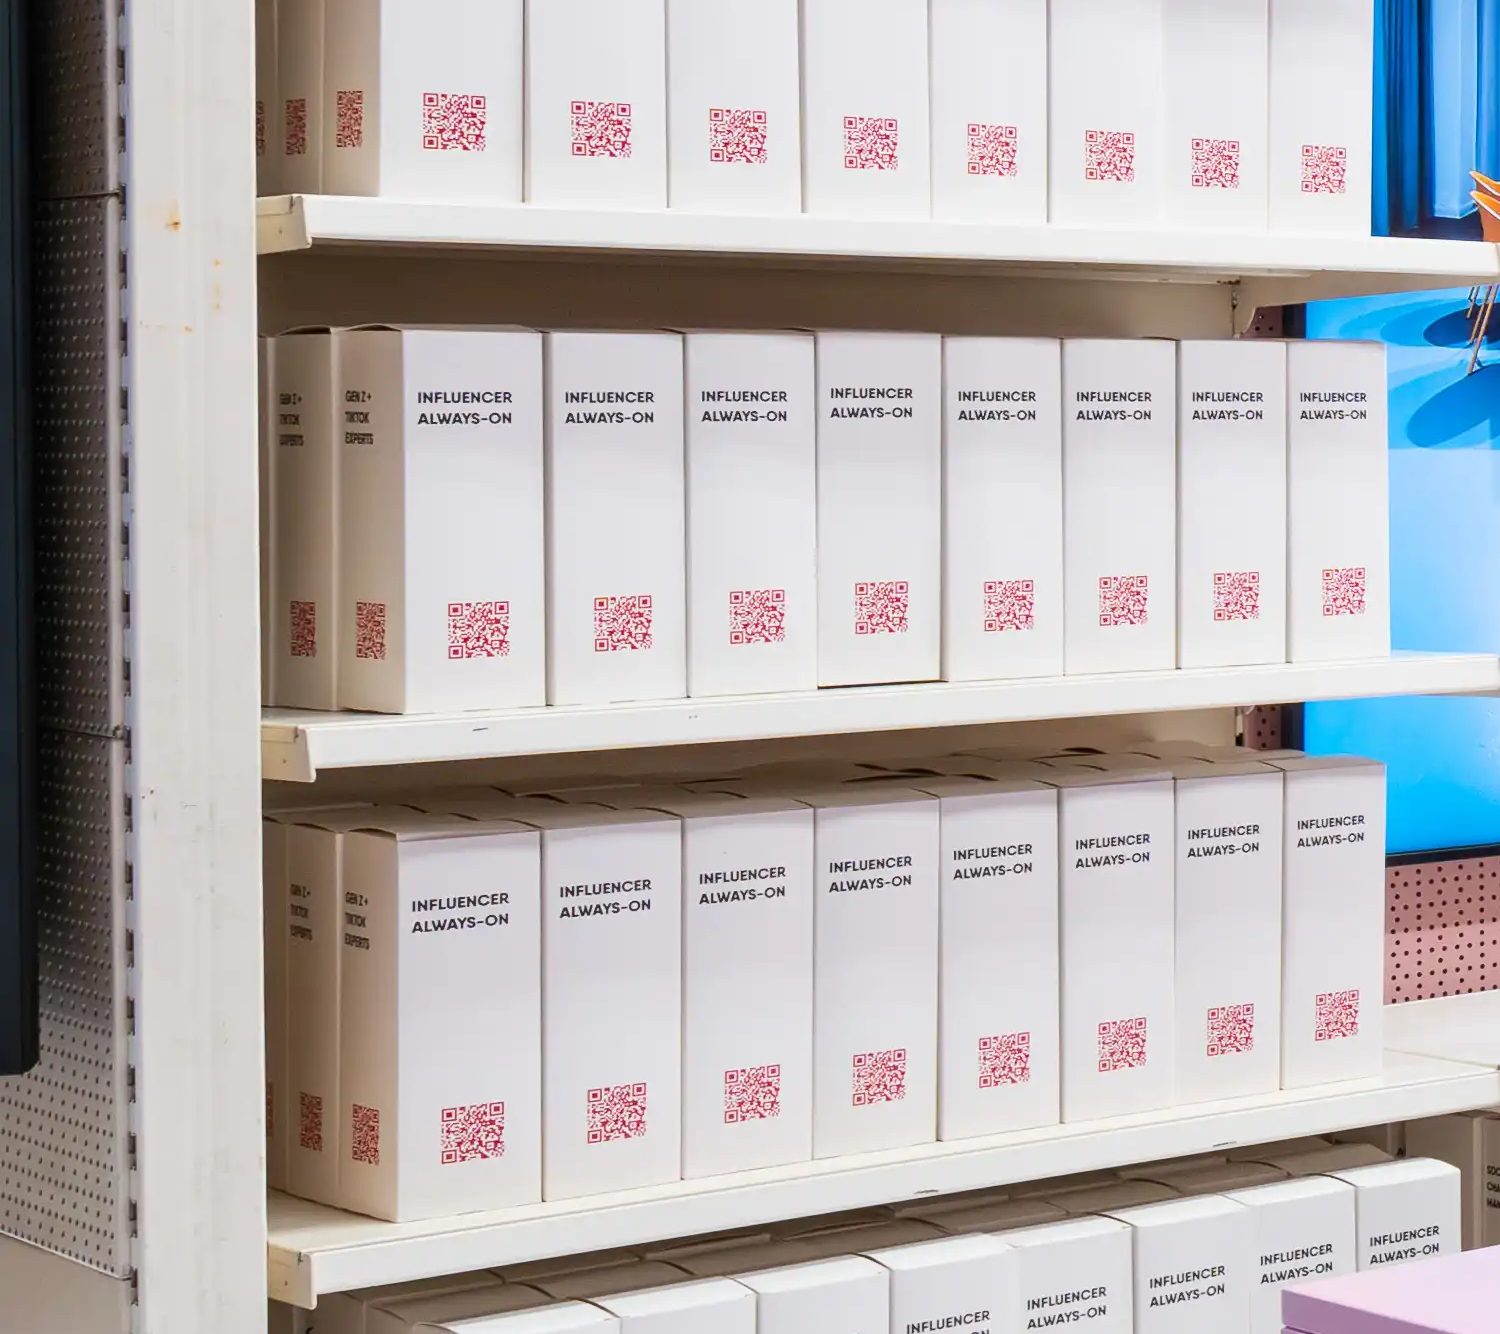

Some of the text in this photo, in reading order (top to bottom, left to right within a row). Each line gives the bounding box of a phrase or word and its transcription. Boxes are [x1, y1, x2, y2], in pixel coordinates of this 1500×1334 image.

[417, 391, 513, 404] INFLUENCER
[830, 387, 913, 399] INFLUENCER
[1076, 391, 1152, 403] INFLUENCER
[417, 412, 512, 425] ALWAYS-ON
[830, 406, 913, 419] ALWAYS-ON
[1076, 409, 1152, 421] ALWAYS-ON
[1297, 814, 1365, 831] INFLUENCER
[1296, 832, 1365, 848] ALWAYS-ON
[953, 843, 1033, 861] INFLUENCER
[699, 866, 786, 885] INFLUENCER
[953, 862, 1033, 881] ALWAYS-ON
[412, 892, 510, 913] INFLUENCER
[698, 885, 786, 905] ALWAYS-ON
[411, 912, 509, 934] ALWAYS-ON
[1260, 1243, 1333, 1267] INFLUENCER
[1260, 1261, 1333, 1285] ALWAYS-ON
[1027, 1286, 1107, 1311] INFLUENCER
[1027, 1304, 1107, 1330] ALWAYS-ON
